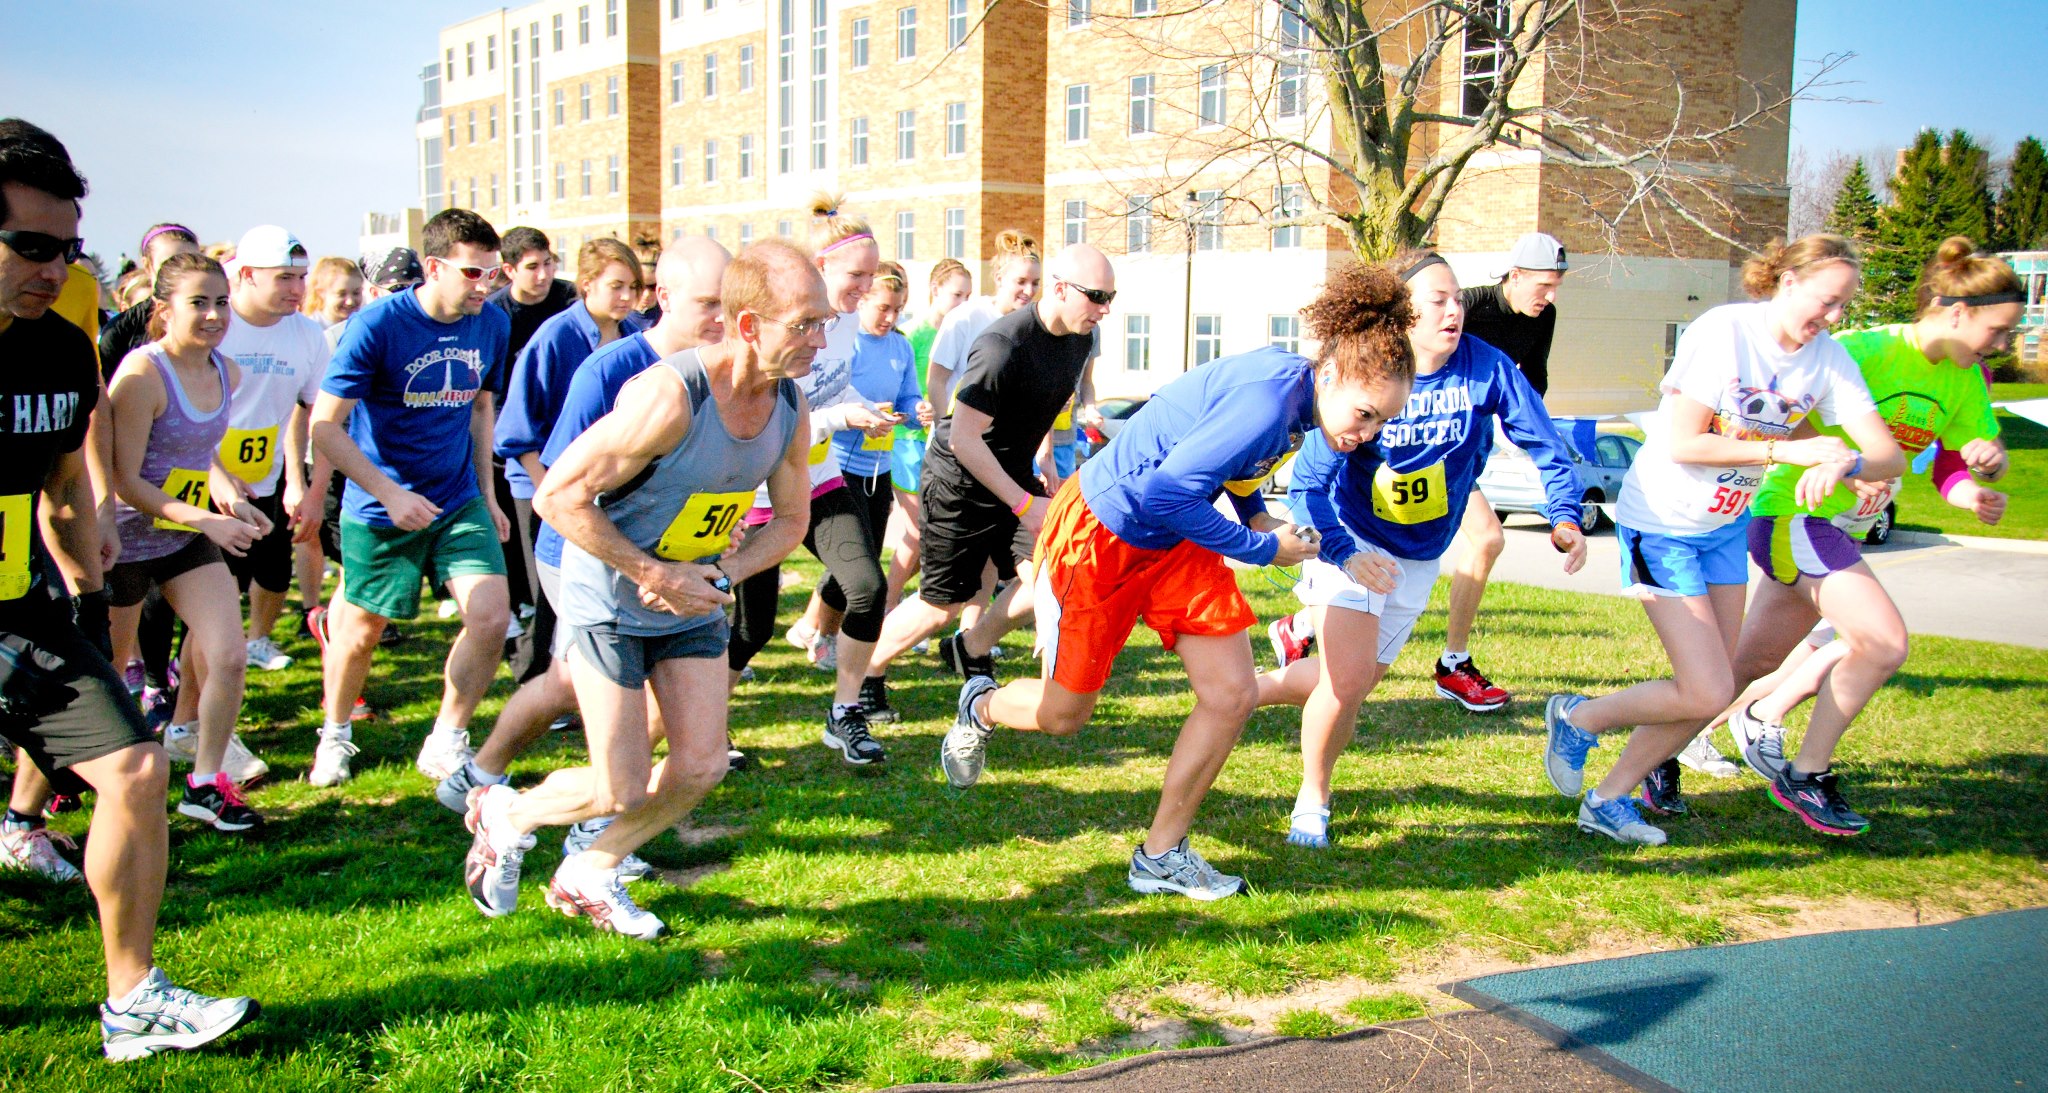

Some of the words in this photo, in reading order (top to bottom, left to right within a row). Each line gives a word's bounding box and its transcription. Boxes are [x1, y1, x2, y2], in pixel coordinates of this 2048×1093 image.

[404, 350, 442, 374] DOOR
[1381, 418, 1465, 449] SOCCER
[238, 436, 268, 464] 63
[175, 480, 206, 507] 45
[1391, 477, 1429, 506] 59
[1707, 486, 1752, 517] 591
[693, 503, 739, 539] 50
